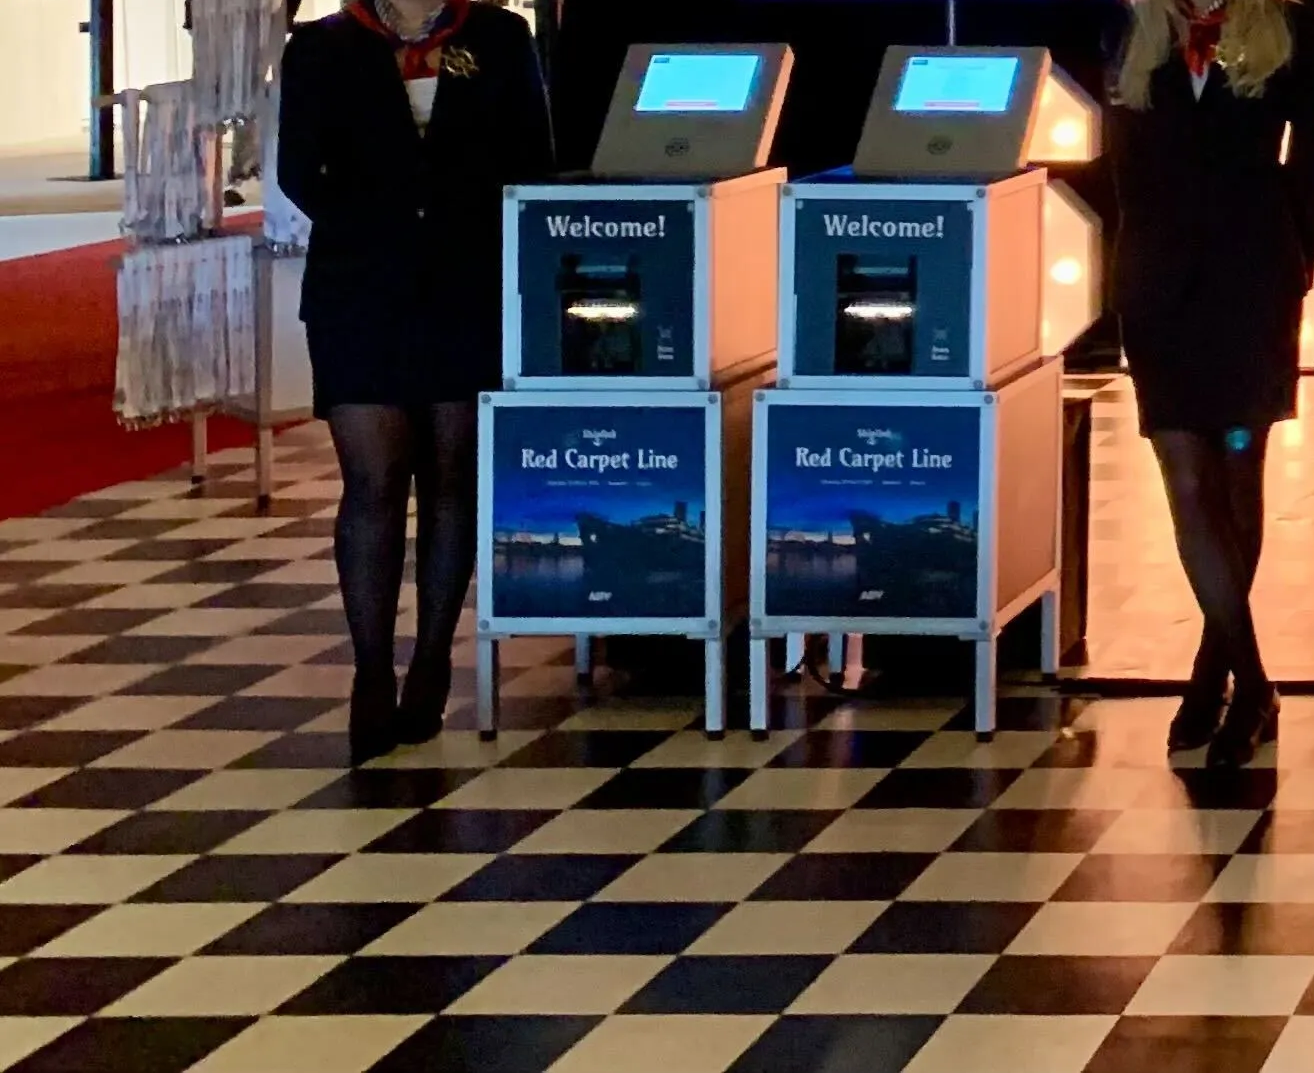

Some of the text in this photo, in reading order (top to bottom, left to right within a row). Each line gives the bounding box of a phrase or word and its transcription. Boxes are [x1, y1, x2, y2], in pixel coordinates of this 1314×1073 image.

[546, 214, 666, 238] Welcome!
[823, 214, 945, 239] Welcome!
[521, 448, 678, 473] Red Carpet Line
[796, 447, 953, 473] Red Carpet Line
